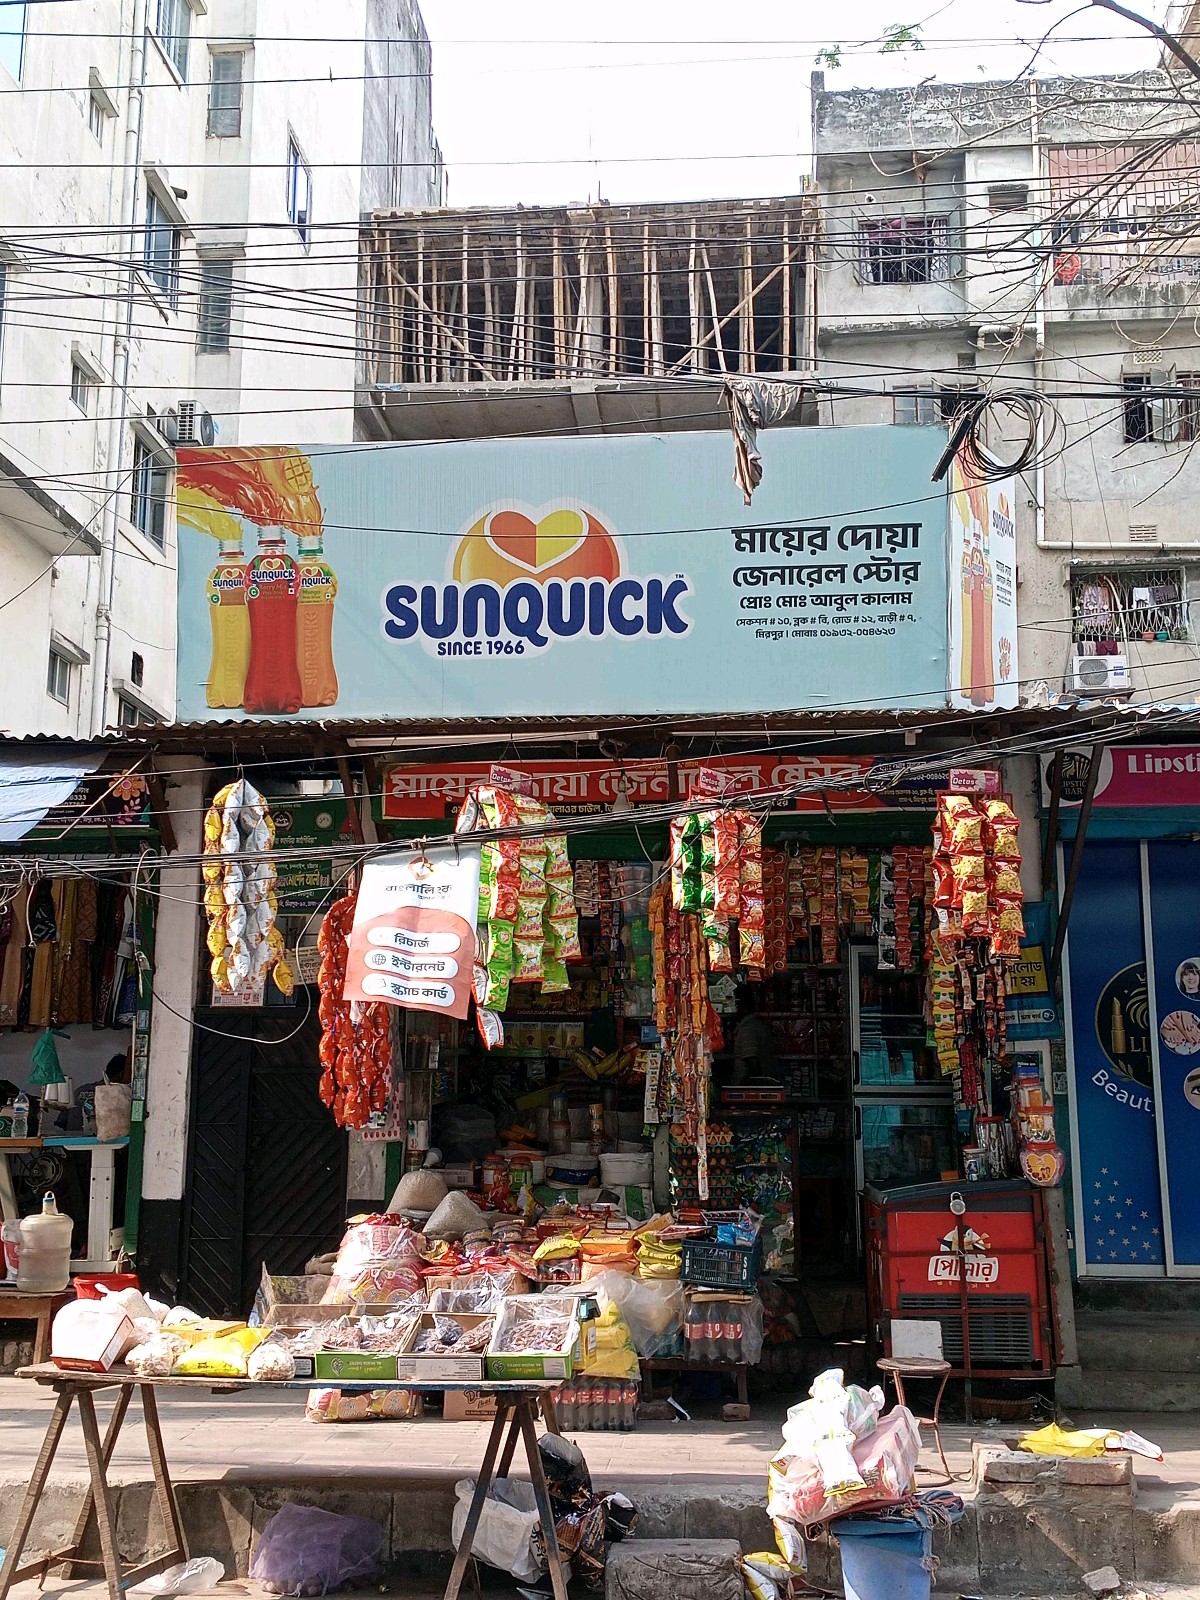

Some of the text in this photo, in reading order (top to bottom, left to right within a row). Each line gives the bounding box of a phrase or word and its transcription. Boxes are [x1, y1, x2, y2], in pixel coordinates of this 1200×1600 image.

[731, 523, 923, 557] মায়ের দোয়া
[250, 570, 296, 580] SUNQUICK
[733, 555, 922, 588] জেনারেল স্টোর
[740, 592, 913, 612] প্রোঃ মোঃ আবুল কালাম
[384, 578, 690, 648] SUNQUICK
[755, 629, 784, 640] মিরপুর
[437, 640, 525, 657] SINCE 1966
[394, 933, 430, 948] রিচার্জ
[391, 955, 446, 973] ইন্টারনেট
[421, 985, 449, 999] কার্ড
